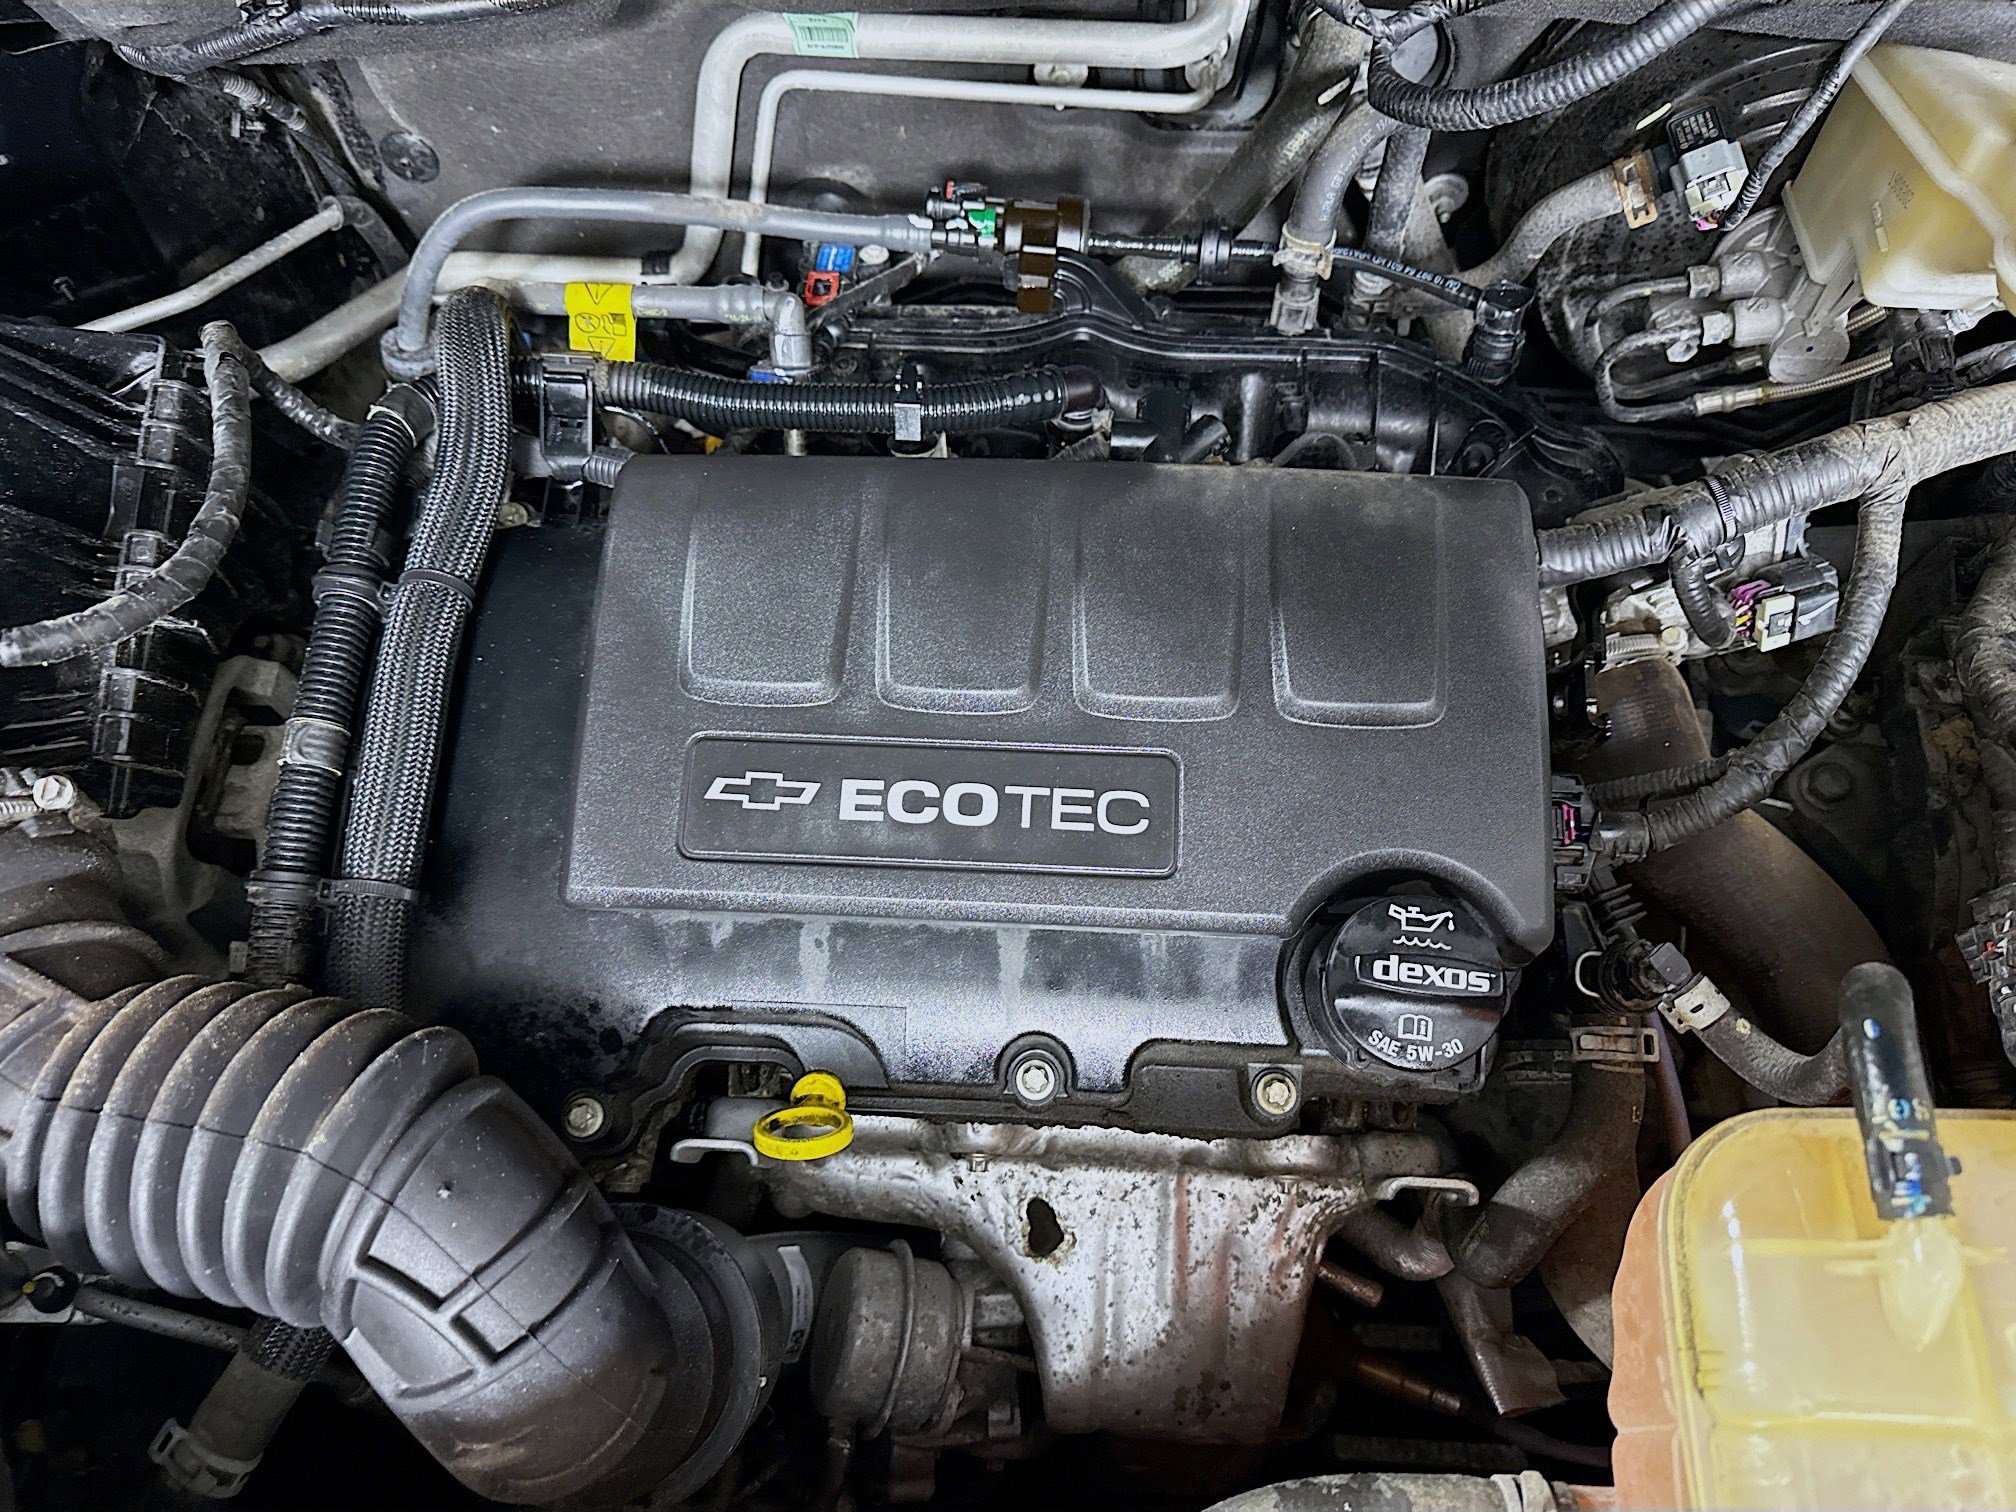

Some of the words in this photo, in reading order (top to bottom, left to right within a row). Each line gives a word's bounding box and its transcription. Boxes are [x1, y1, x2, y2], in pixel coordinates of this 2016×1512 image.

[838, 778, 1151, 835] ECOTEC
[1372, 954, 1492, 993] dexos
[1367, 1029, 1401, 1058] SAE
[1405, 1038, 1464, 1062] 5W-30
